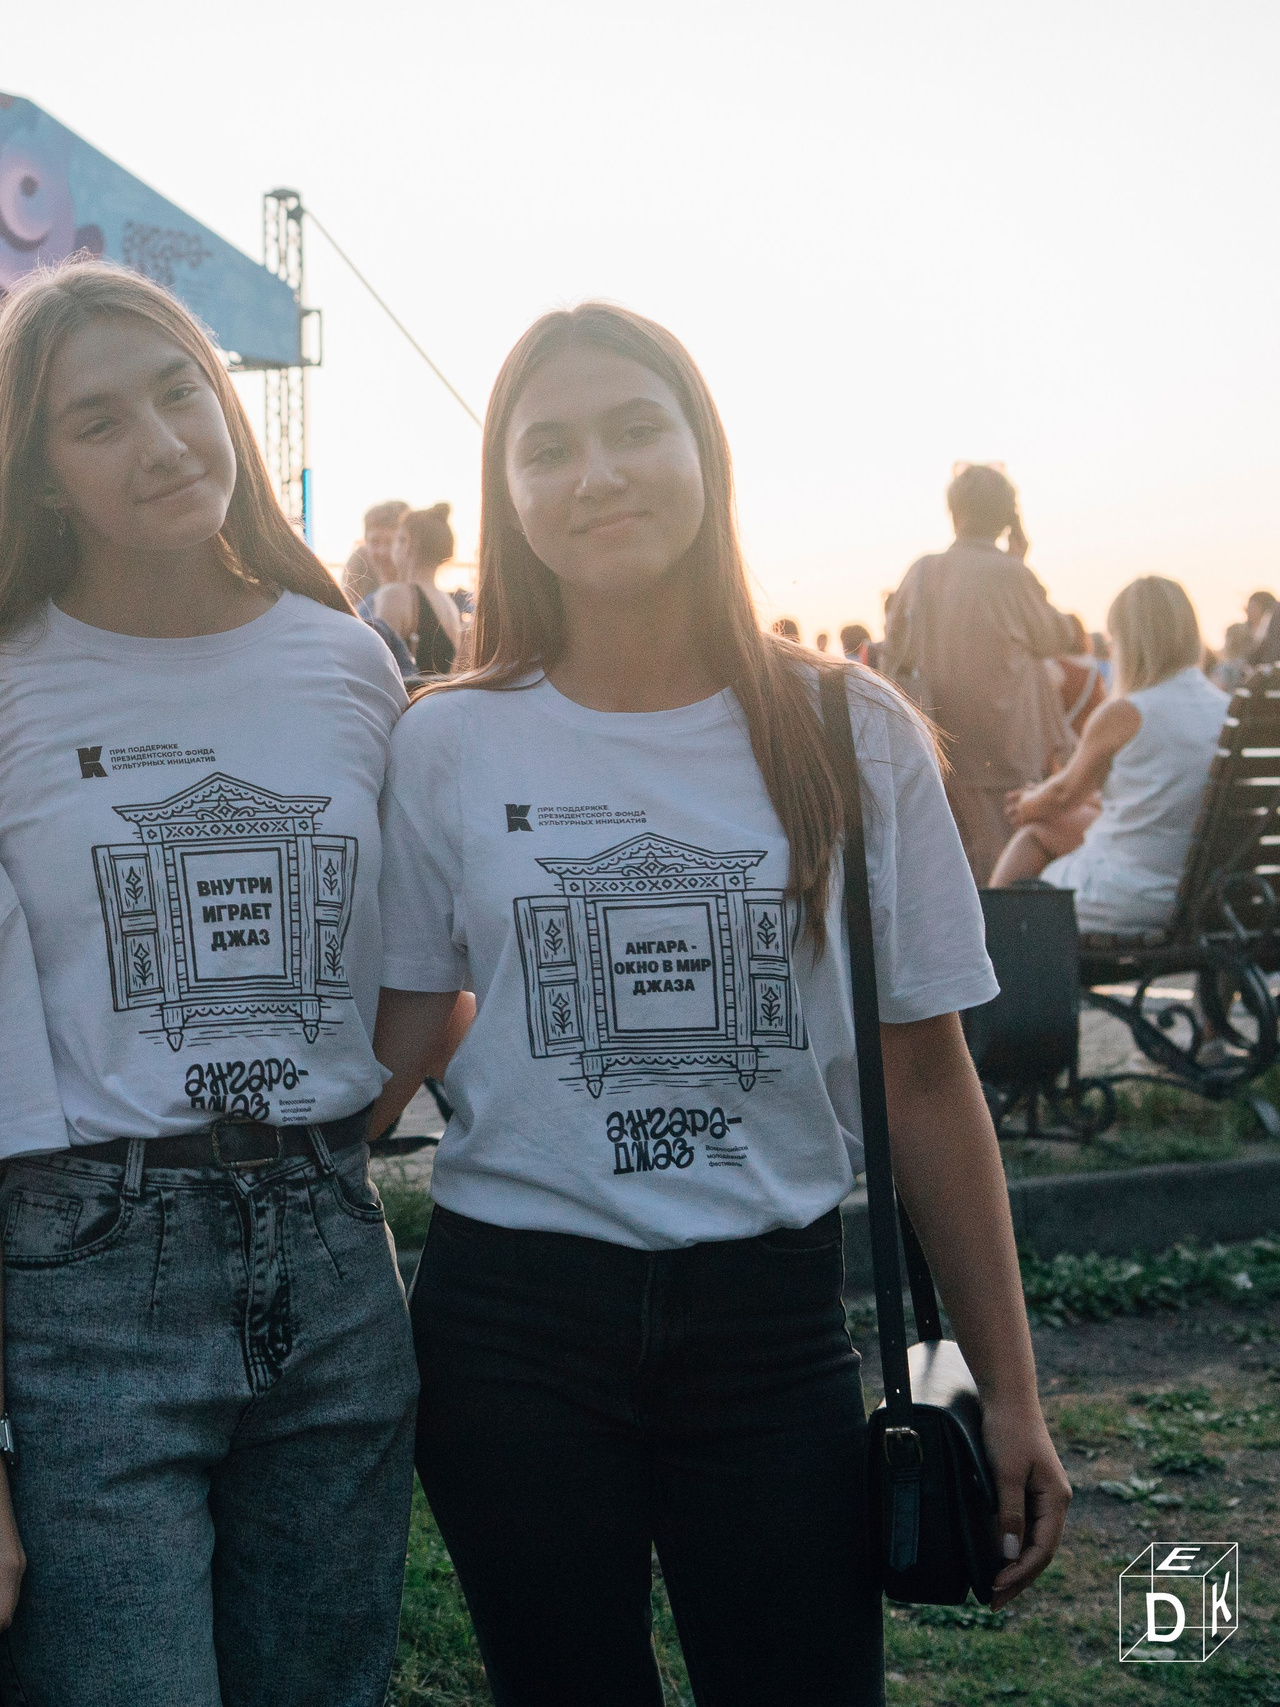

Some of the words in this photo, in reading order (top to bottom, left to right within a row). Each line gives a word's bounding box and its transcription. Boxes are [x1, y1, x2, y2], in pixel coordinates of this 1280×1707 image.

[111, 751, 183, 762] ПРЕЗИДЕНТСКОГО
[184, 748, 215, 756] ФОНДА
[128, 743, 178, 753] ПОДДЕРЖКЕ
[112, 760, 165, 771] КУЛЬТУРНЫХ
[167, 756, 216, 765] ИНИЦИАТИВ
[538, 811, 612, 819] ПРЕЗИДЕНТСКОГО
[556, 804, 609, 812] ПОДДЕРЖКЕ
[595, 817, 647, 825] ИНИЦИАТИВ
[197, 877, 272, 897] ВНУТРИ
[202, 903, 272, 923] ИГРАЕТ
[211, 929, 271, 951] ДЖАЗ
[625, 940, 688, 955] АНГАРА
[614, 960, 659, 975] ОКНО
[662, 960, 673, 973] В
[676, 958, 712, 972] МИР
[632, 979, 695, 996] ДЖАЗА
[708, 1160, 743, 1168] фестиваль
